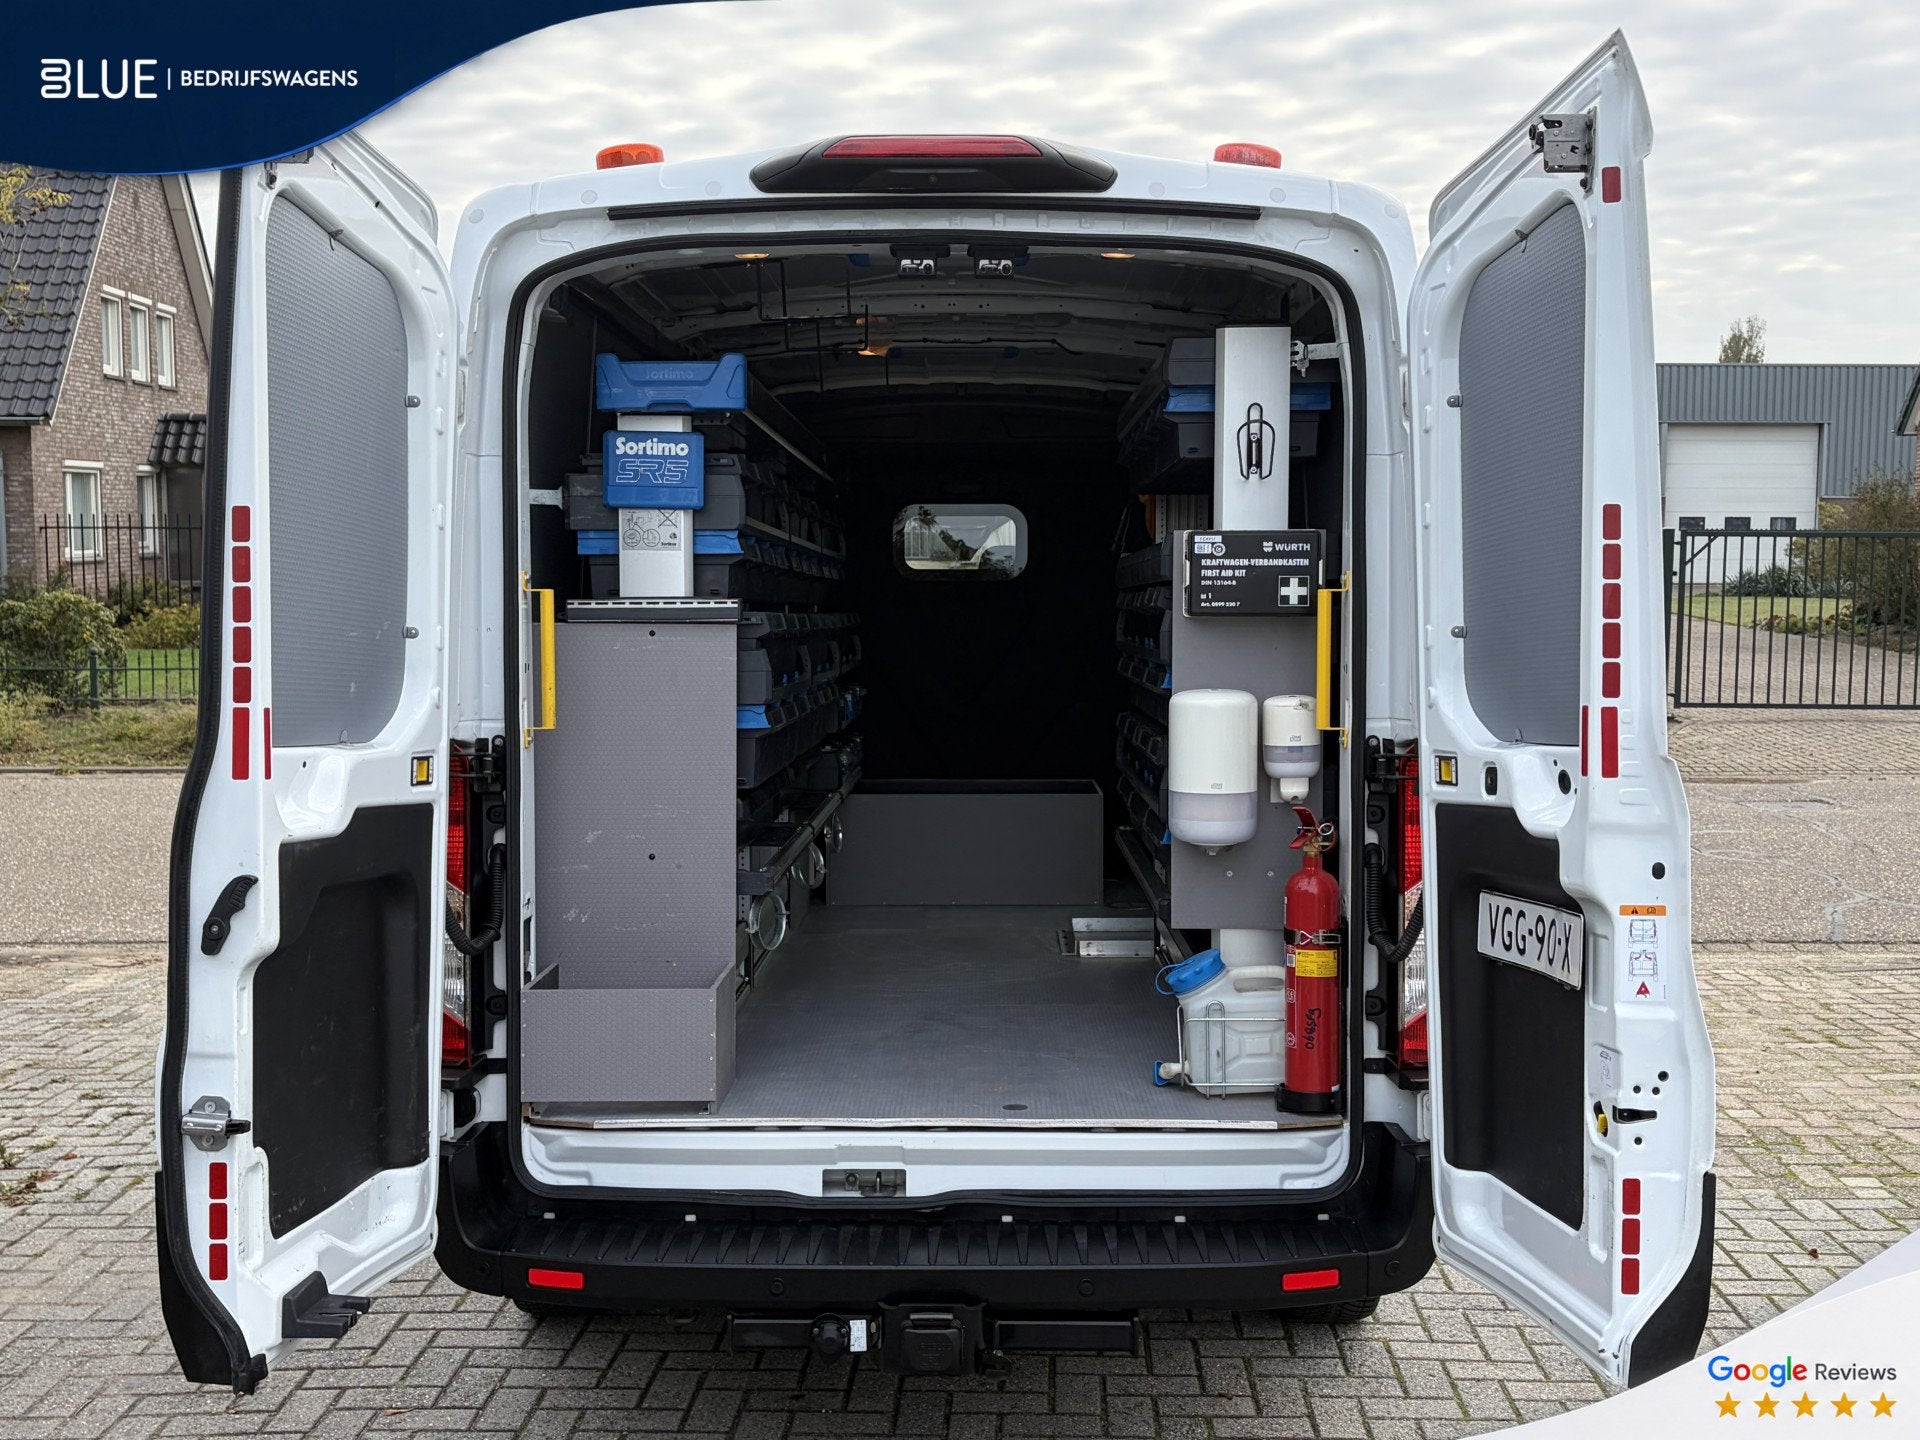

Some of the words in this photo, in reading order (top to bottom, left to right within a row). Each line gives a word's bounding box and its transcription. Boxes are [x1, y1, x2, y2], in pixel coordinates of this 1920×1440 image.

[615, 437, 690, 456] Sortimo
[1274, 543, 1311, 551] WÜRTH
[1201, 569, 1220, 577] FIRST
[1220, 569, 1234, 577] AID
[1234, 569, 1247, 577] KIT
[1488, 902, 1572, 974] VGG-90-X
